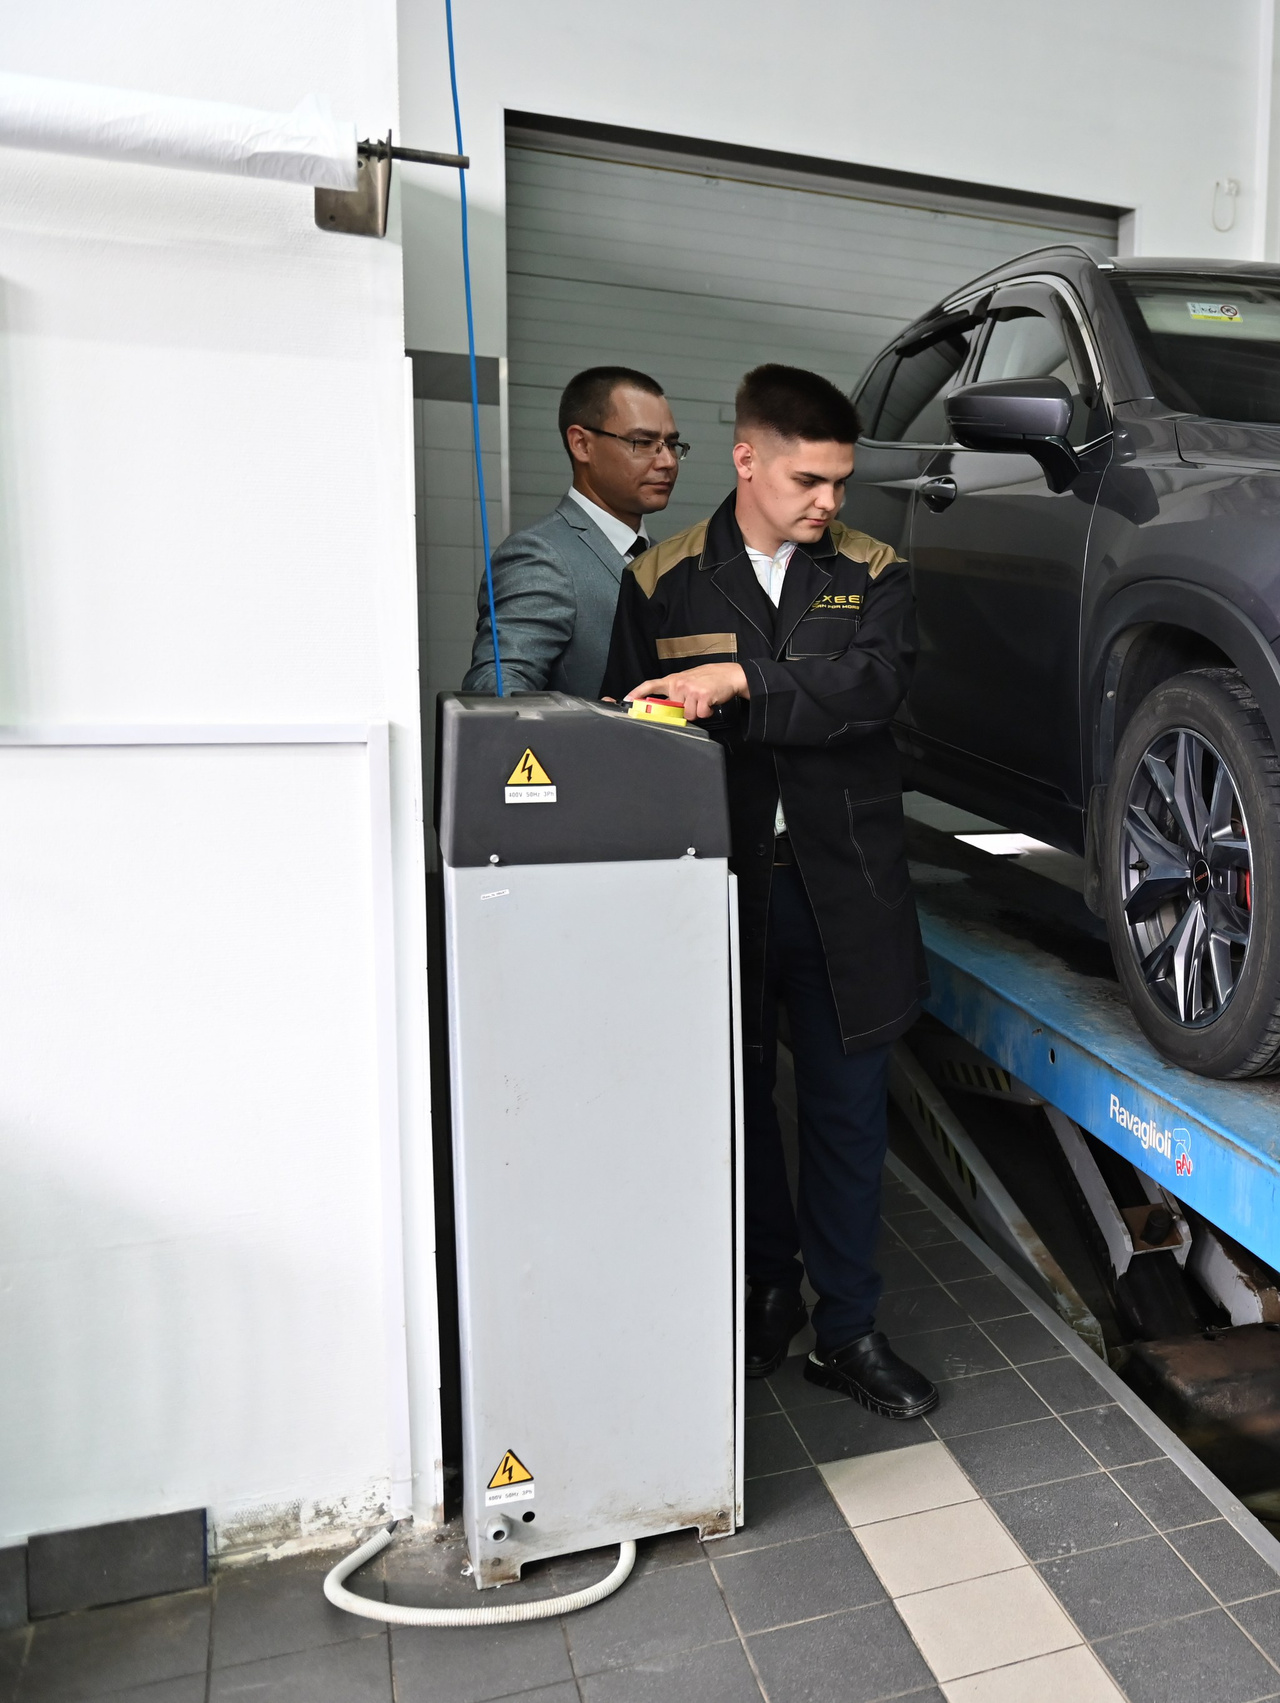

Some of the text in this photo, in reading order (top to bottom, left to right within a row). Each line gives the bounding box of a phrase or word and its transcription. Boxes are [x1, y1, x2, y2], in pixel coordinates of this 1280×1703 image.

[815, 594, 864, 604] XEE
[1110, 1093, 1172, 1160] Ravaglioli
[1175, 1152, 1193, 1176] RAV
